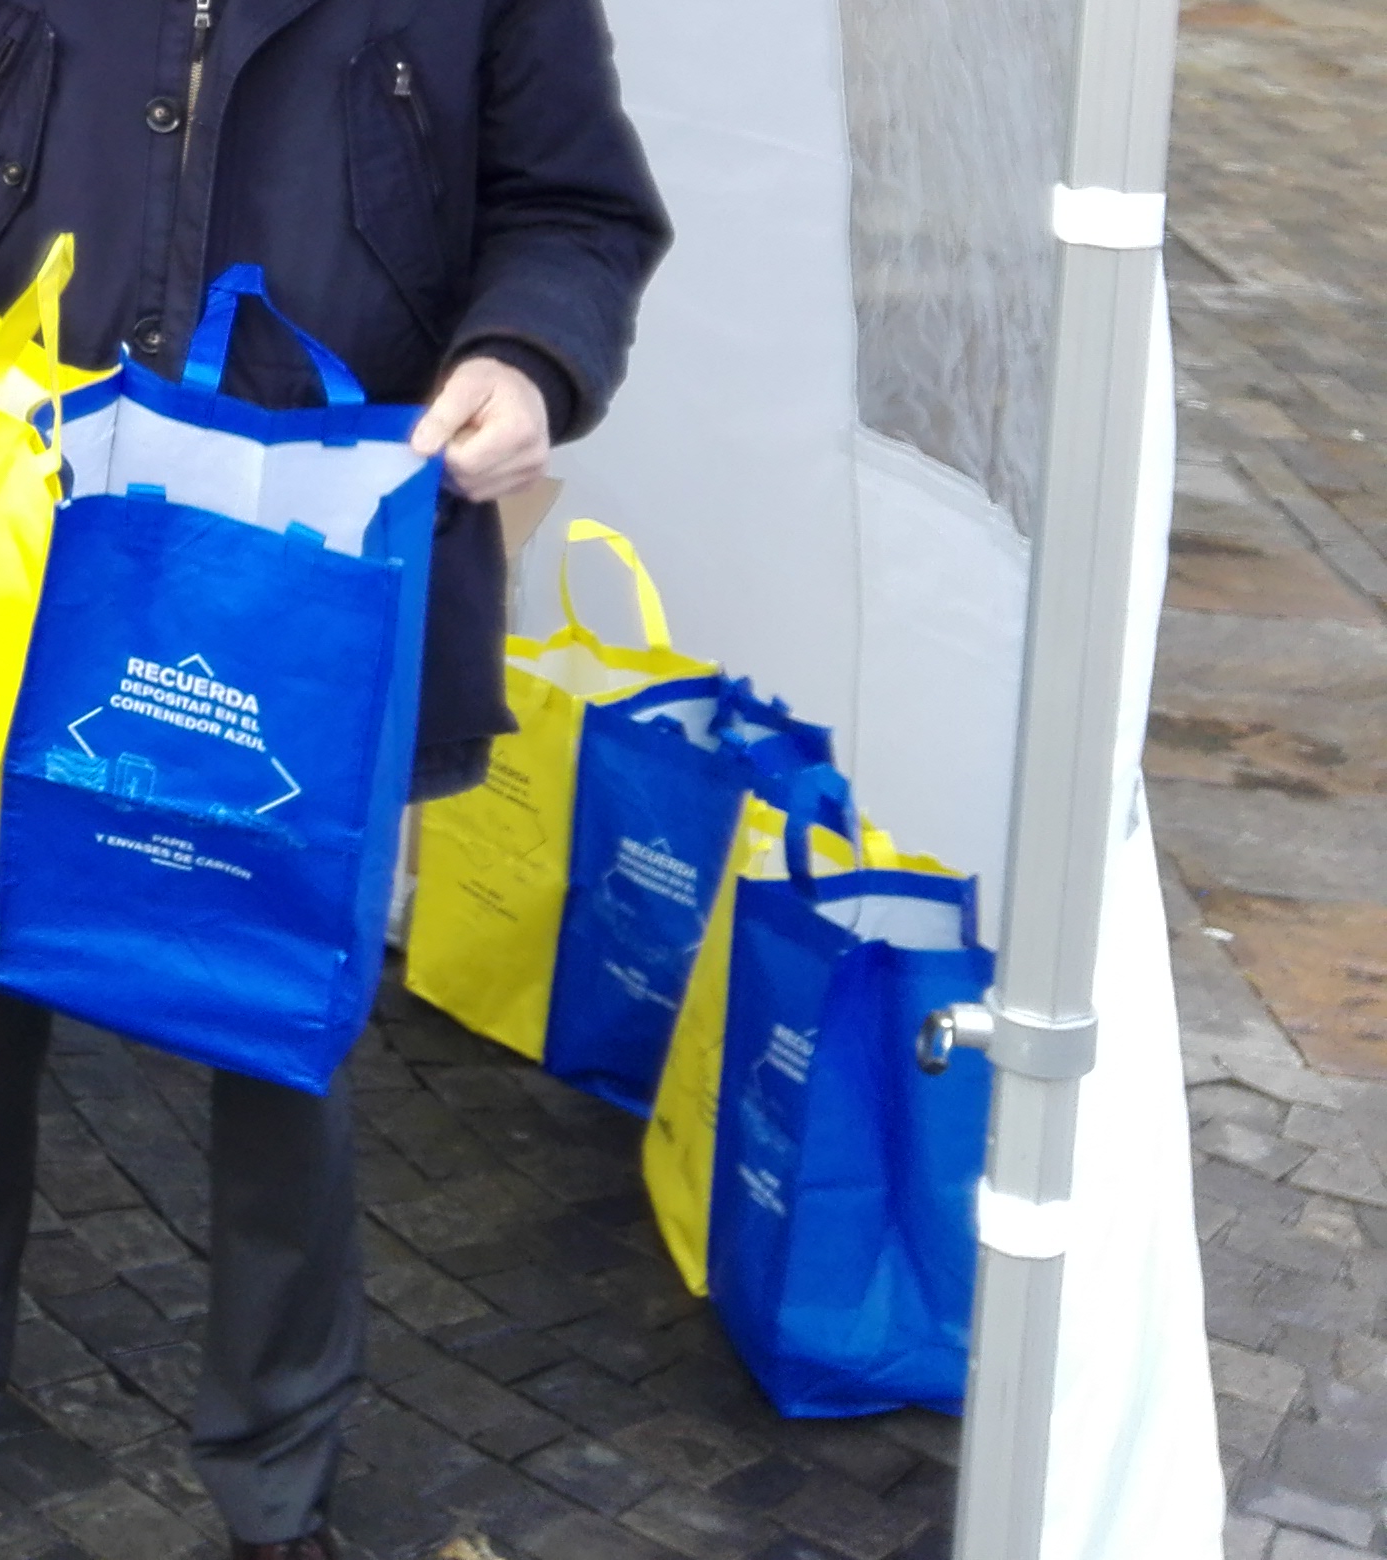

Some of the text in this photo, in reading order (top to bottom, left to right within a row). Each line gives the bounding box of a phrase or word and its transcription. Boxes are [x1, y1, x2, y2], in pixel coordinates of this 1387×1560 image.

[120, 679, 260, 732] DEPOSITAR EN EL
[128, 656, 259, 714] RECUERDA
[110, 695, 266, 753] CONTENEDOR AZUL
[95, 833, 253, 880] Y ENVASES DE CARTÓN
[151, 834, 195, 852] PAPEL
